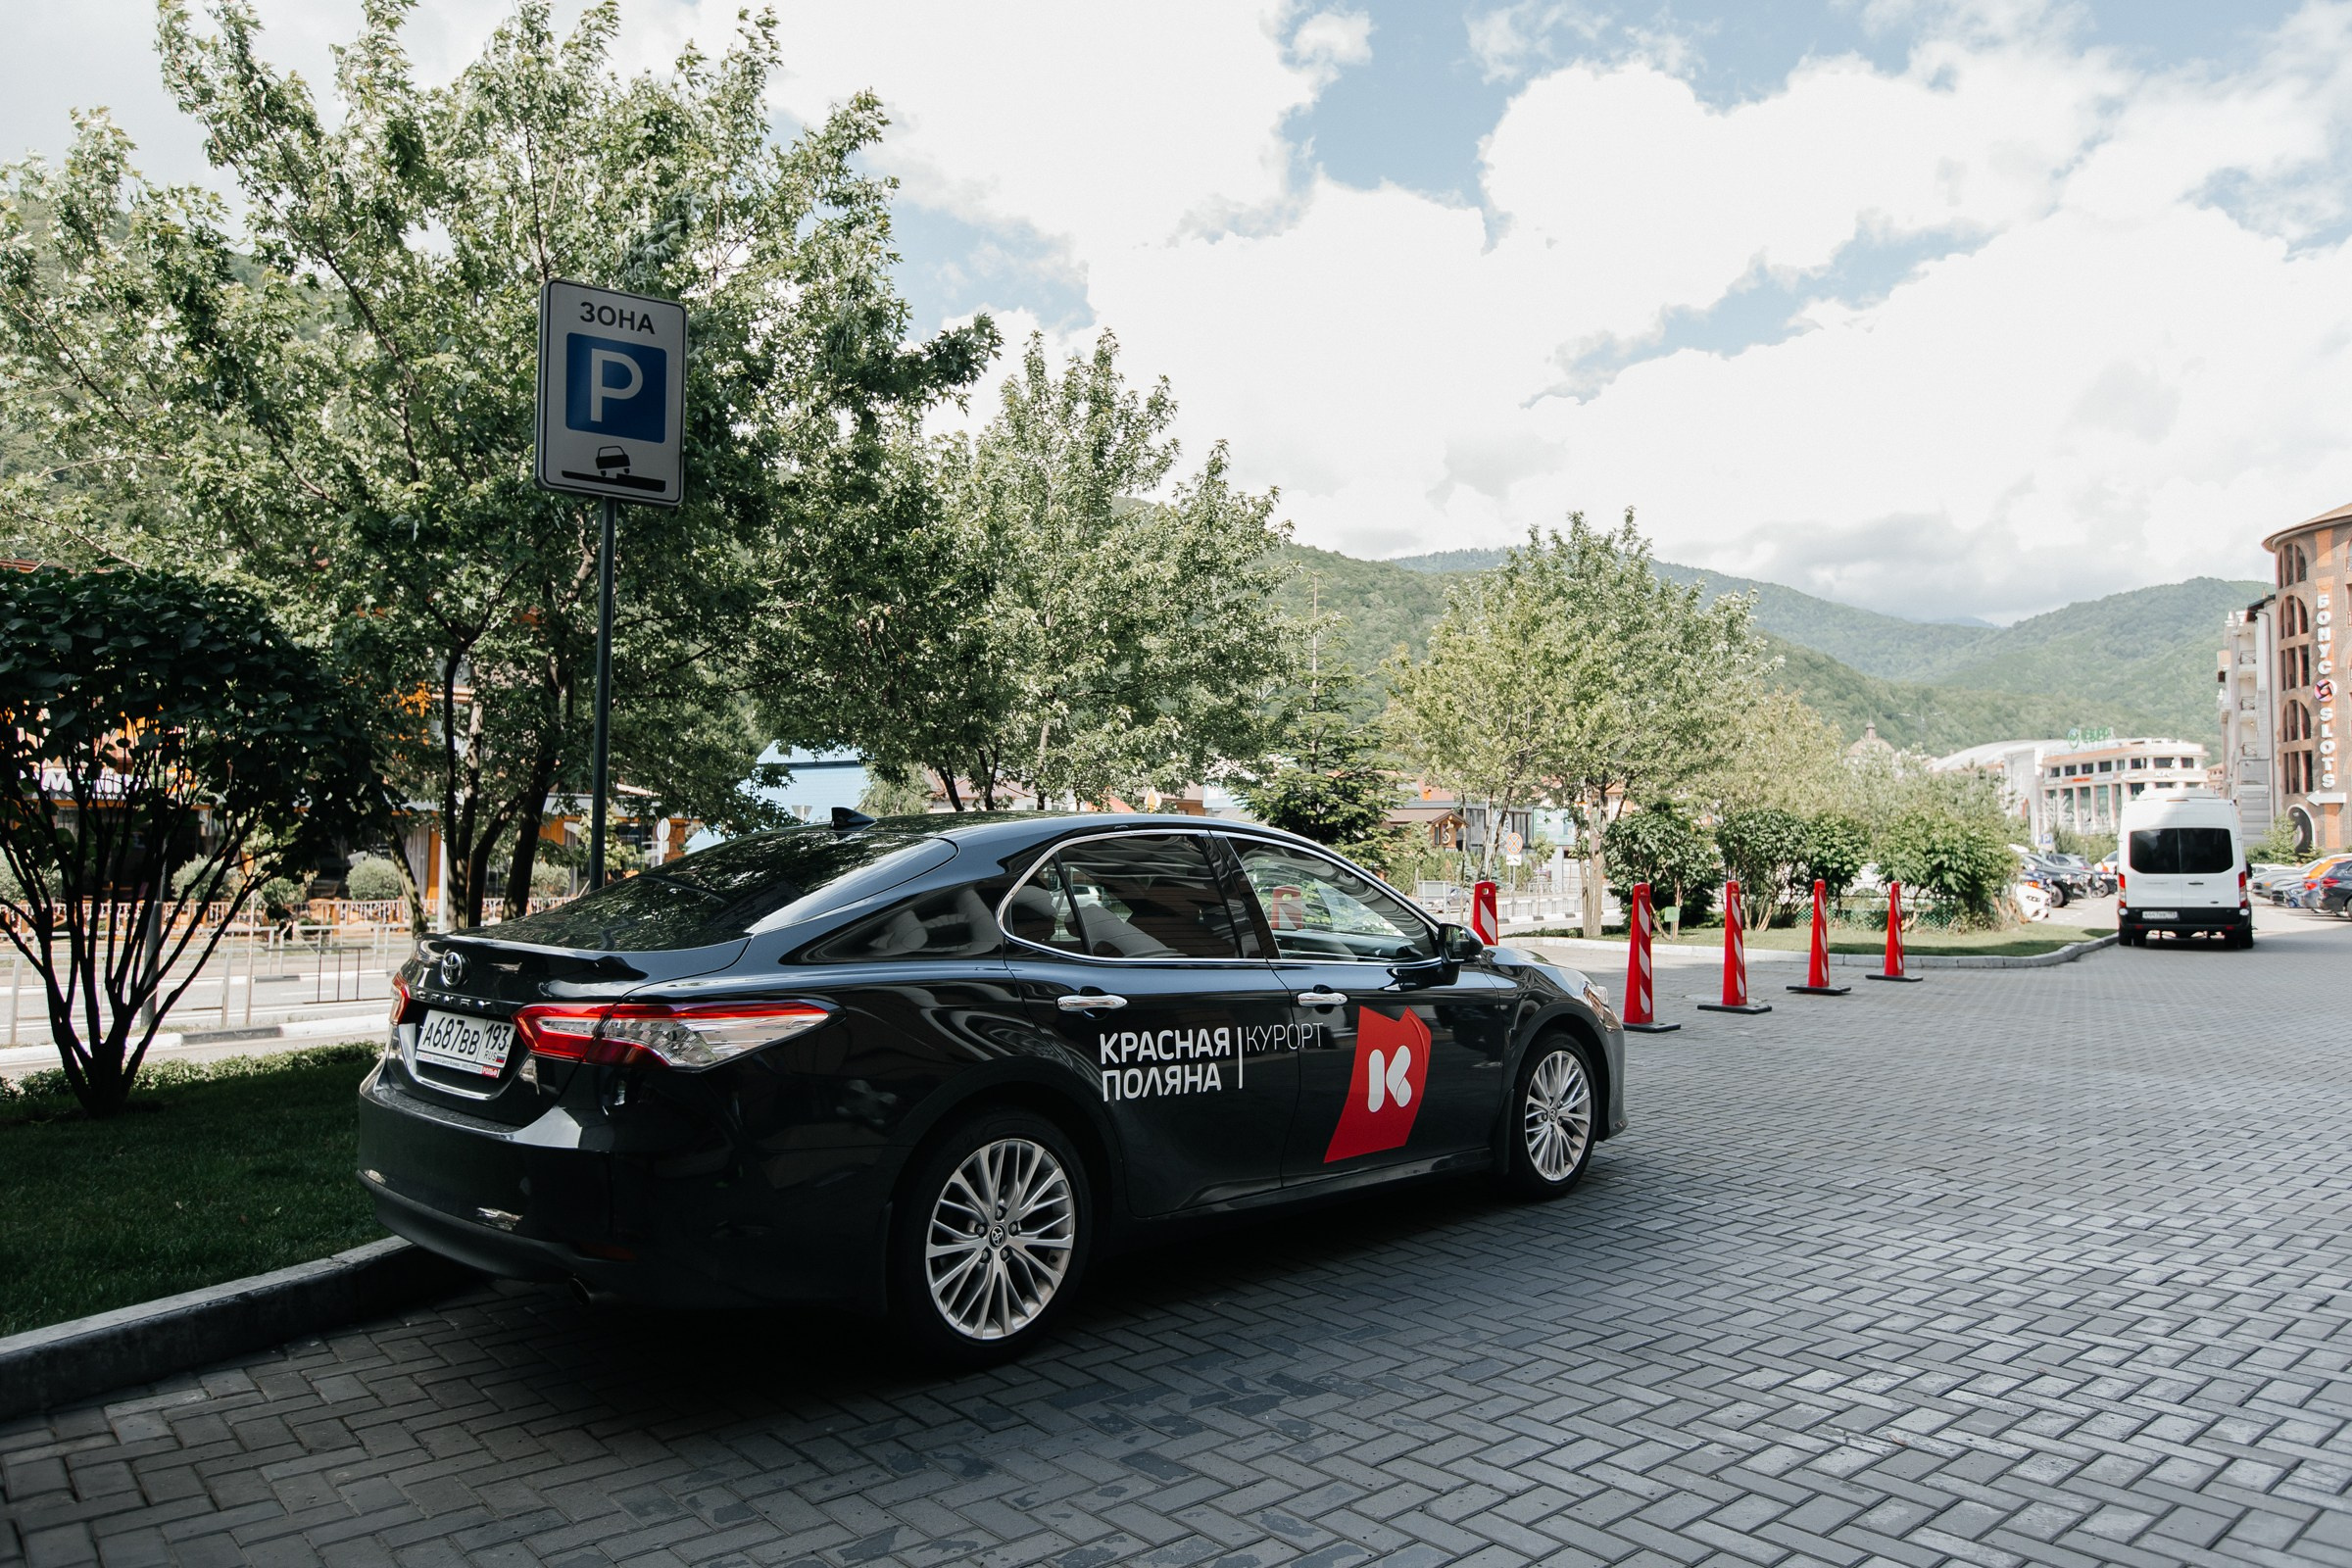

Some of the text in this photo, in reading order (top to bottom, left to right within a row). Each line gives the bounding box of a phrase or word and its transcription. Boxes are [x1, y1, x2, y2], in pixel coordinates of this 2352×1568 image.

[580, 301, 656, 335] ЗОНА
[590, 348, 644, 422] P
[2317, 594, 2332, 675] БОНУС
[2320, 707, 2336, 789] SLOTS
[416, 990, 492, 1008] CAMRY
[485, 1023, 512, 1052] 193
[1100, 1026, 1231, 1065] КРАСНАЯ
[1246, 1022, 1324, 1053] КУРОРТ
[484, 1051, 498, 1061] RUS
[1102, 1062, 1222, 1102] ПОЛЯНА
